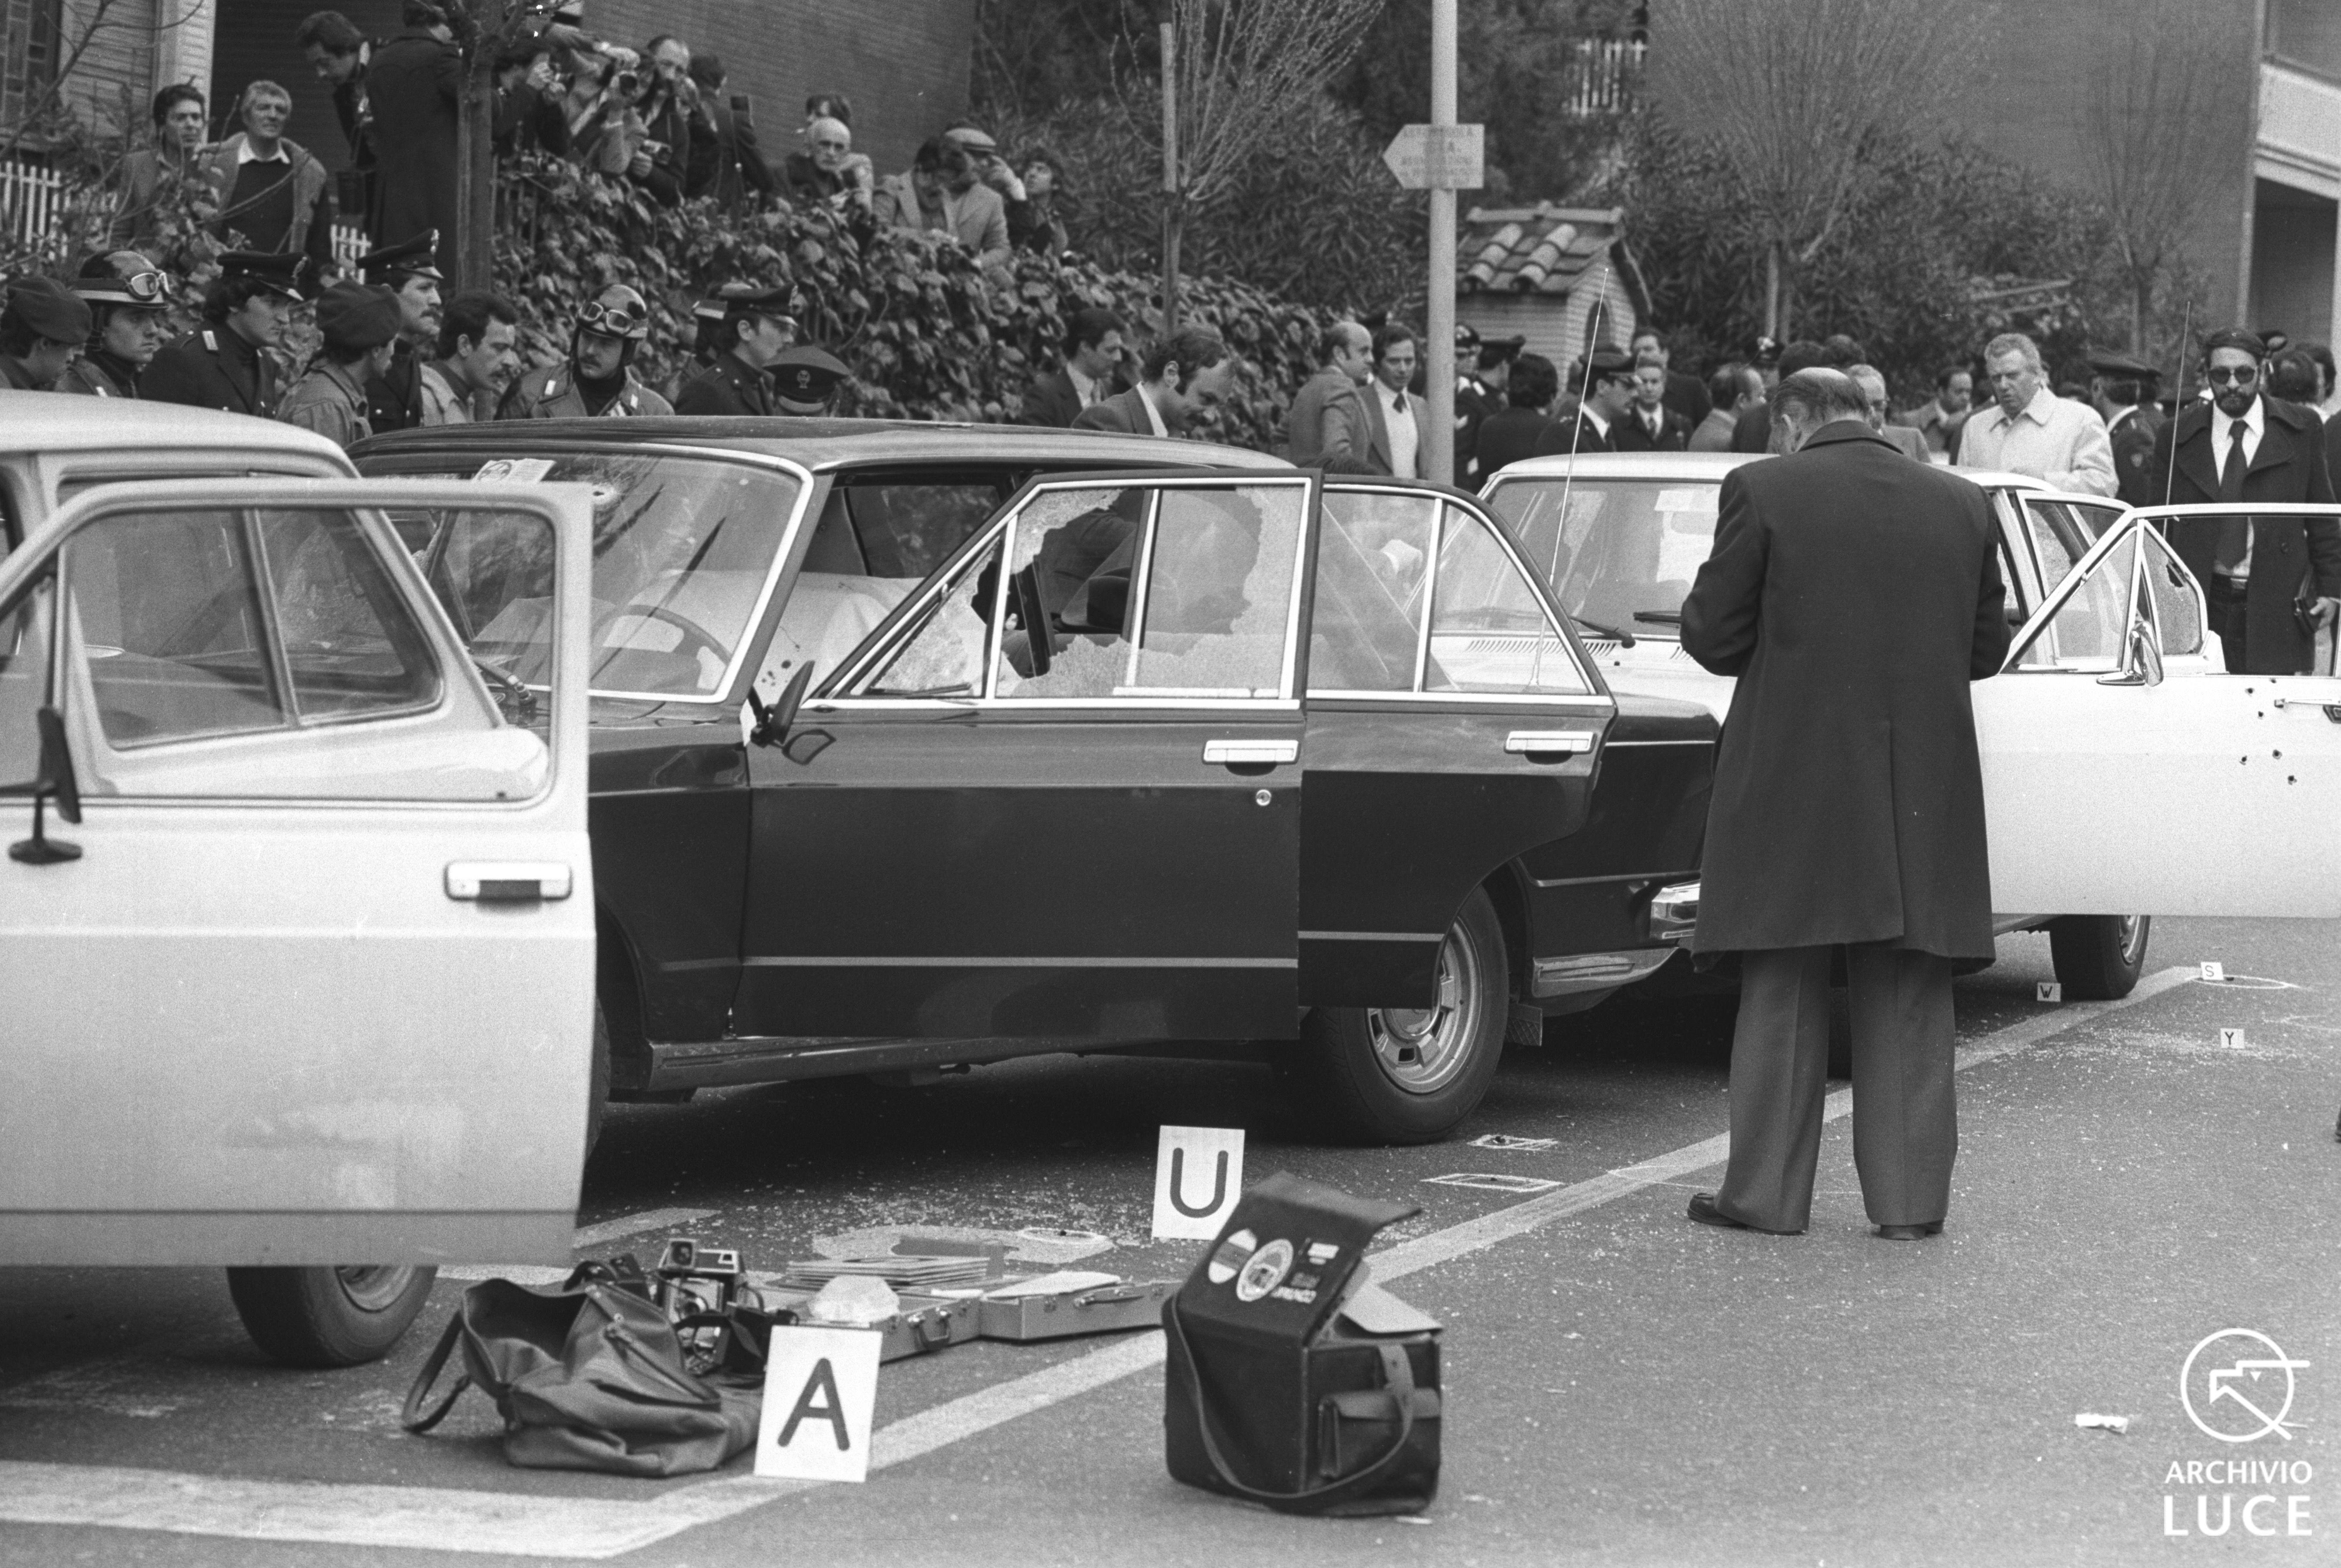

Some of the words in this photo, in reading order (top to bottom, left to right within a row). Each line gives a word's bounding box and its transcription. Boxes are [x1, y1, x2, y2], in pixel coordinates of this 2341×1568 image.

[2205, 965, 2214, 977] S
[2039, 985, 2053, 999] W
[2224, 1031, 2235, 1045] Y
[1169, 1147, 1229, 1219] U
[777, 1357, 851, 1451] A
